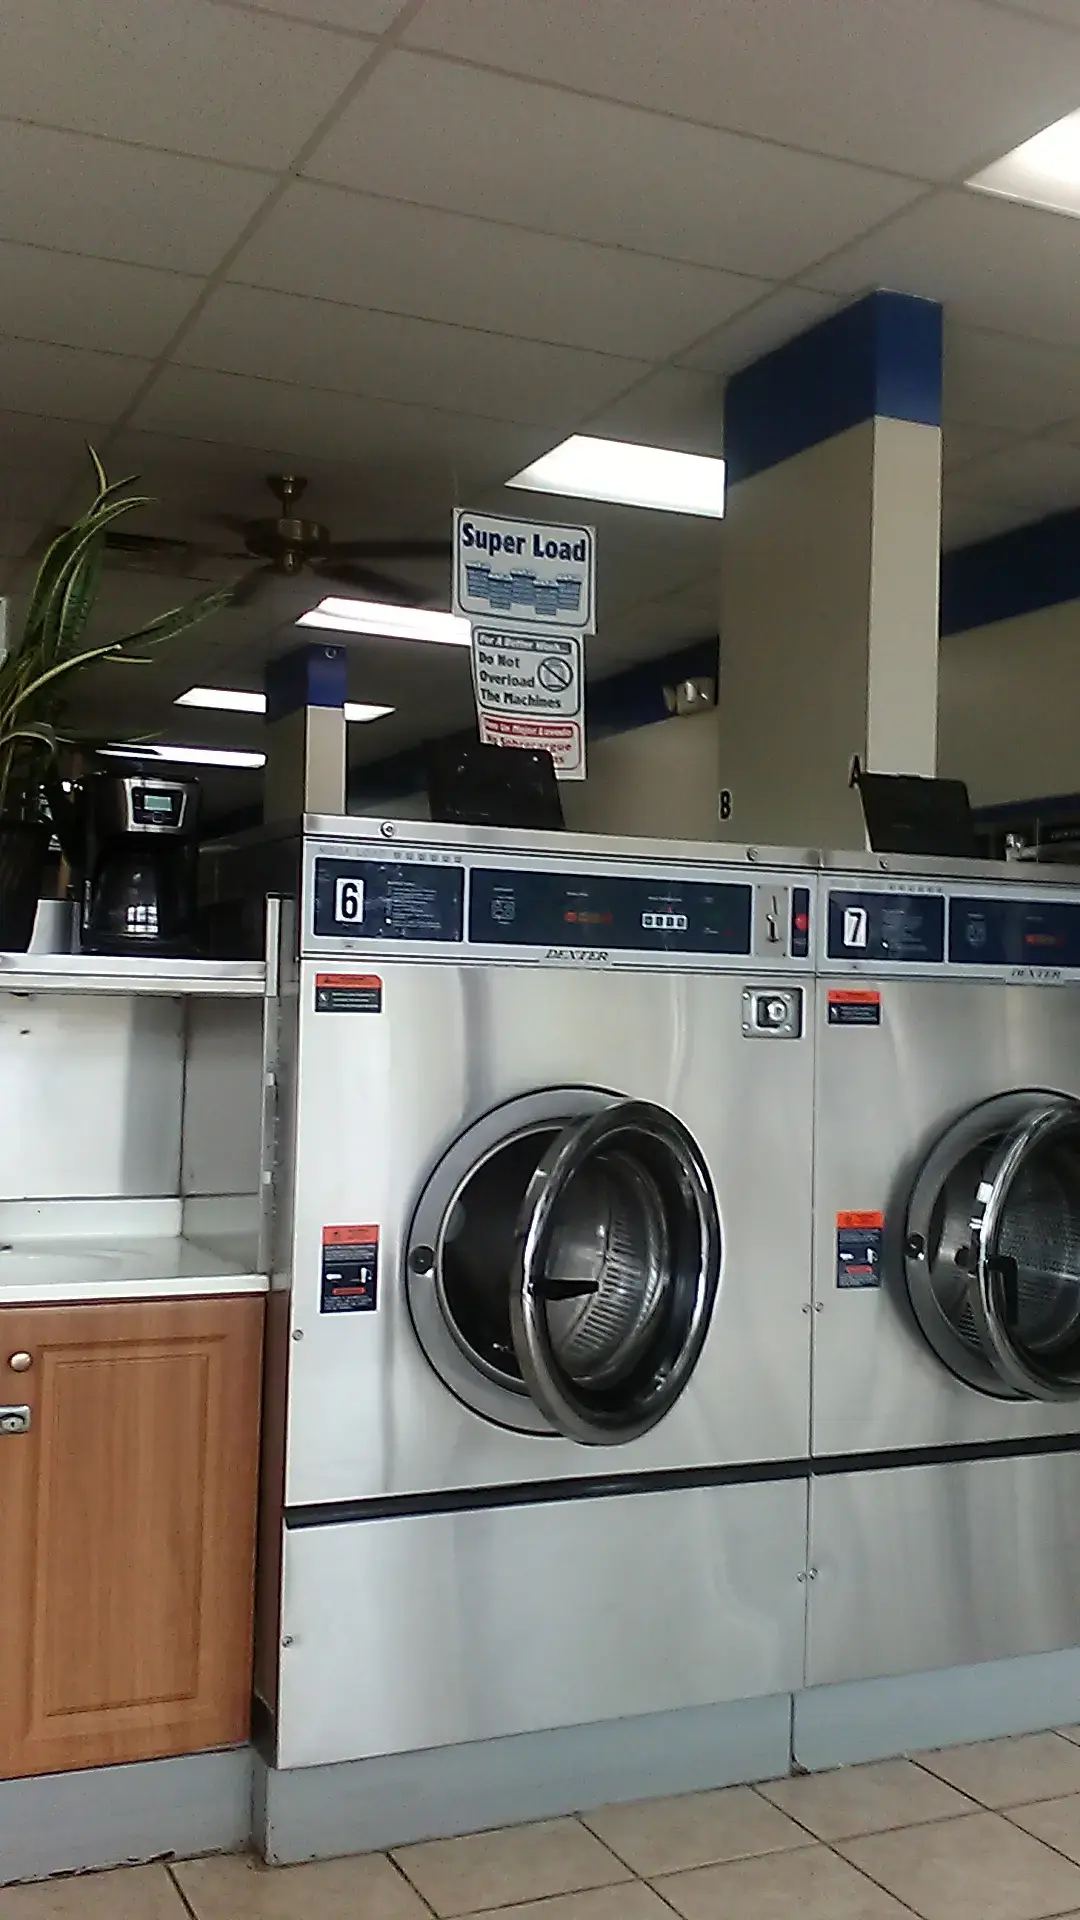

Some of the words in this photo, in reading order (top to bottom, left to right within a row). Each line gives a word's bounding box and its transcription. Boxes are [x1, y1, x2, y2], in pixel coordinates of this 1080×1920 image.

[462, 522, 526, 556] Super
[532, 533, 586, 561] Load
[480, 652, 494, 665] Do
[498, 655, 520, 668] Not
[480, 670, 535, 688] Overload
[481, 689, 500, 703] The
[504, 692, 562, 708] Machines
[341, 882, 358, 919] 6
[848, 911, 861, 942] 7
[545, 949, 609, 961] DEXTER
